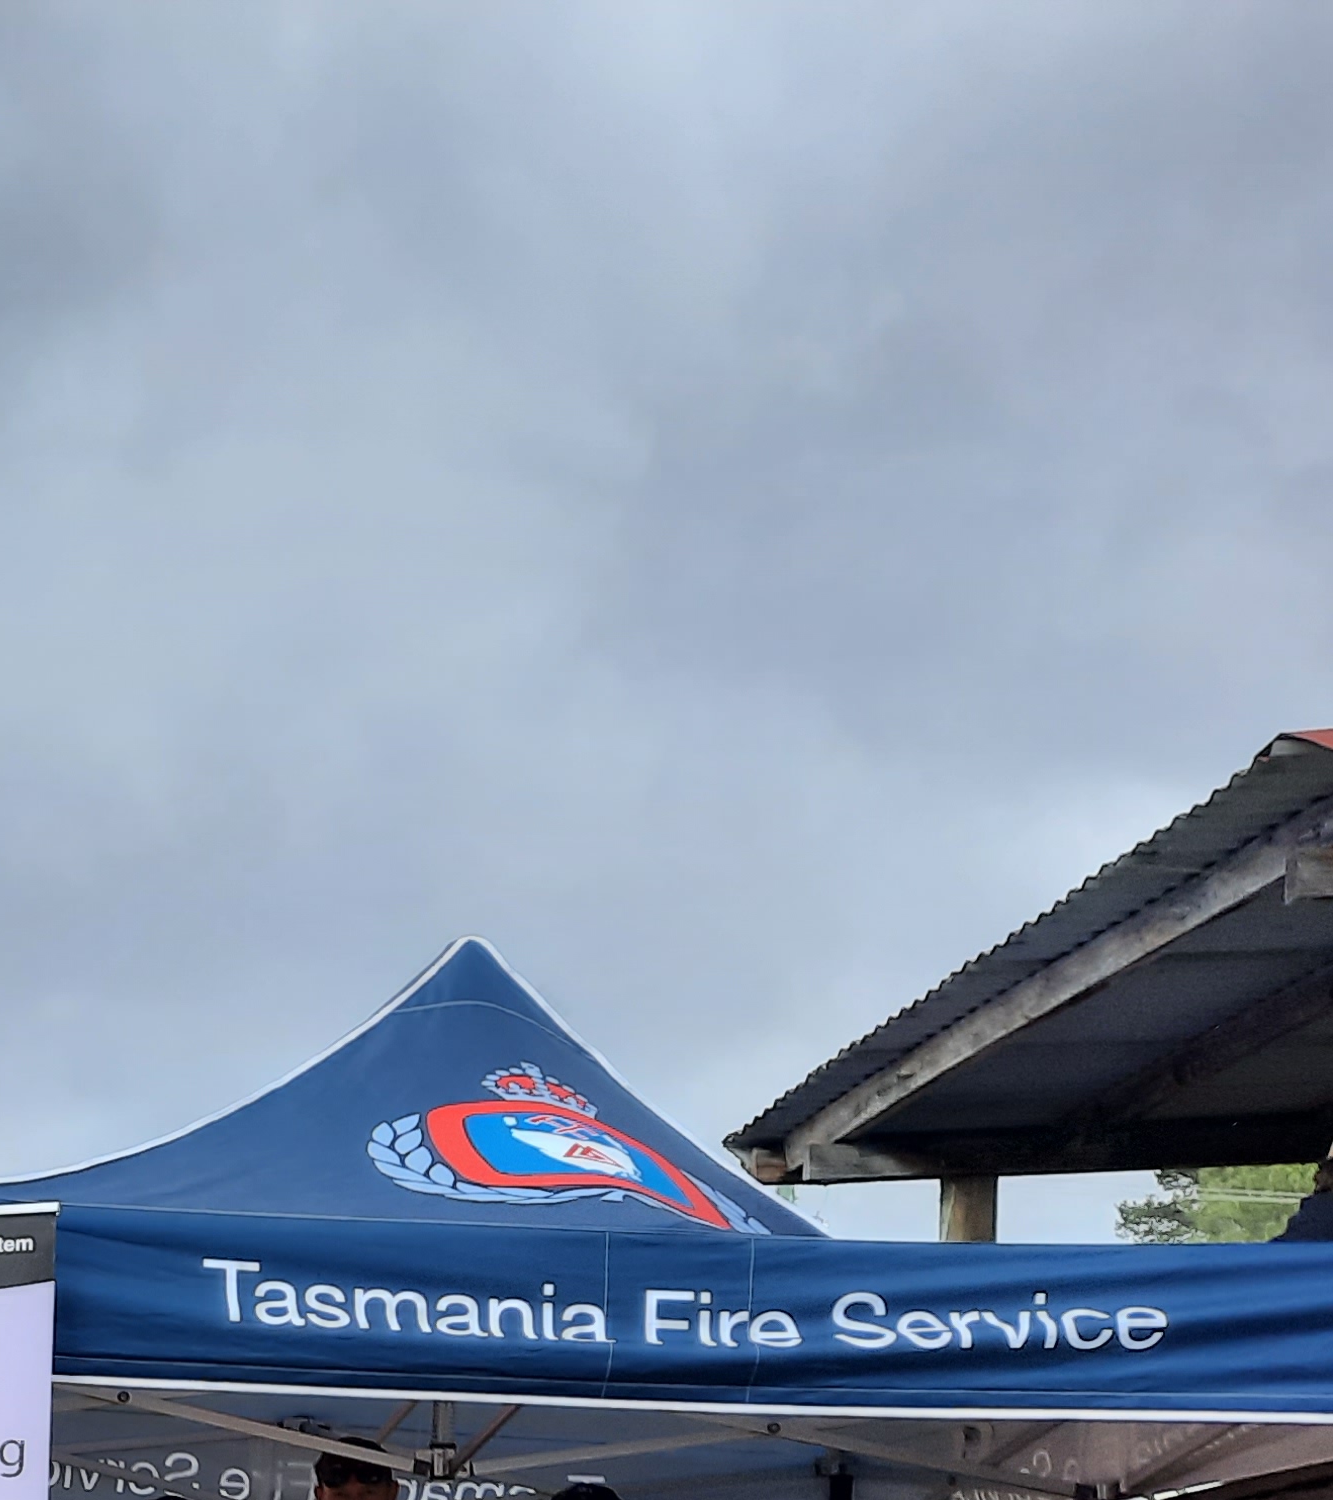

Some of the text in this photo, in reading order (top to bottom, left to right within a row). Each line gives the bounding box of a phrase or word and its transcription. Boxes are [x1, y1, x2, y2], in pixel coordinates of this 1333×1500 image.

[202, 1256, 1170, 1351] Tasmania Fire Service
